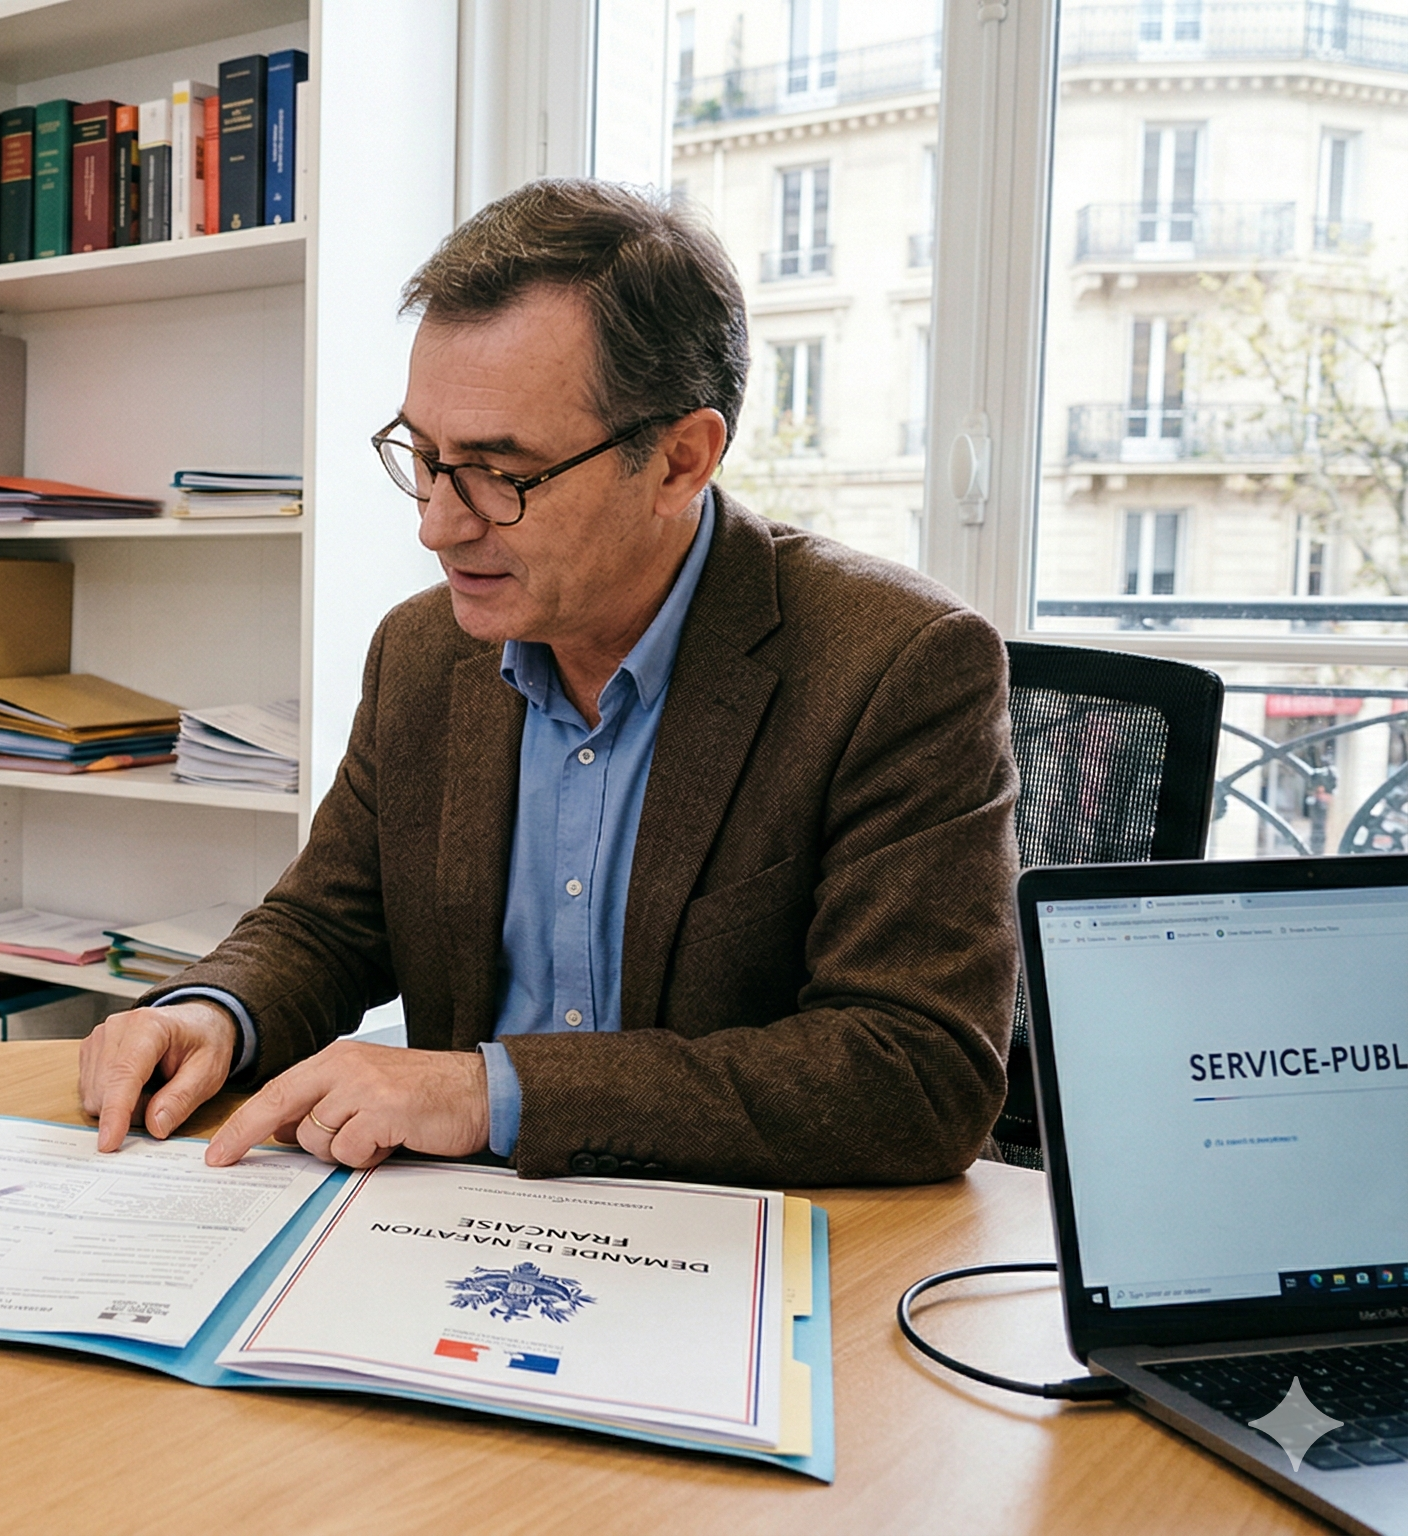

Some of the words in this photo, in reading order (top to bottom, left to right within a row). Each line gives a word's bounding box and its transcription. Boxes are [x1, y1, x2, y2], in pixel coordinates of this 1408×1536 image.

[1190, 1044, 1408, 1082] SERVICE-PUBL
[458, 1218, 629, 1248] FRANCAISE
[519, 1240, 554, 1254] DE
[564, 1246, 708, 1274] DEMANDE
